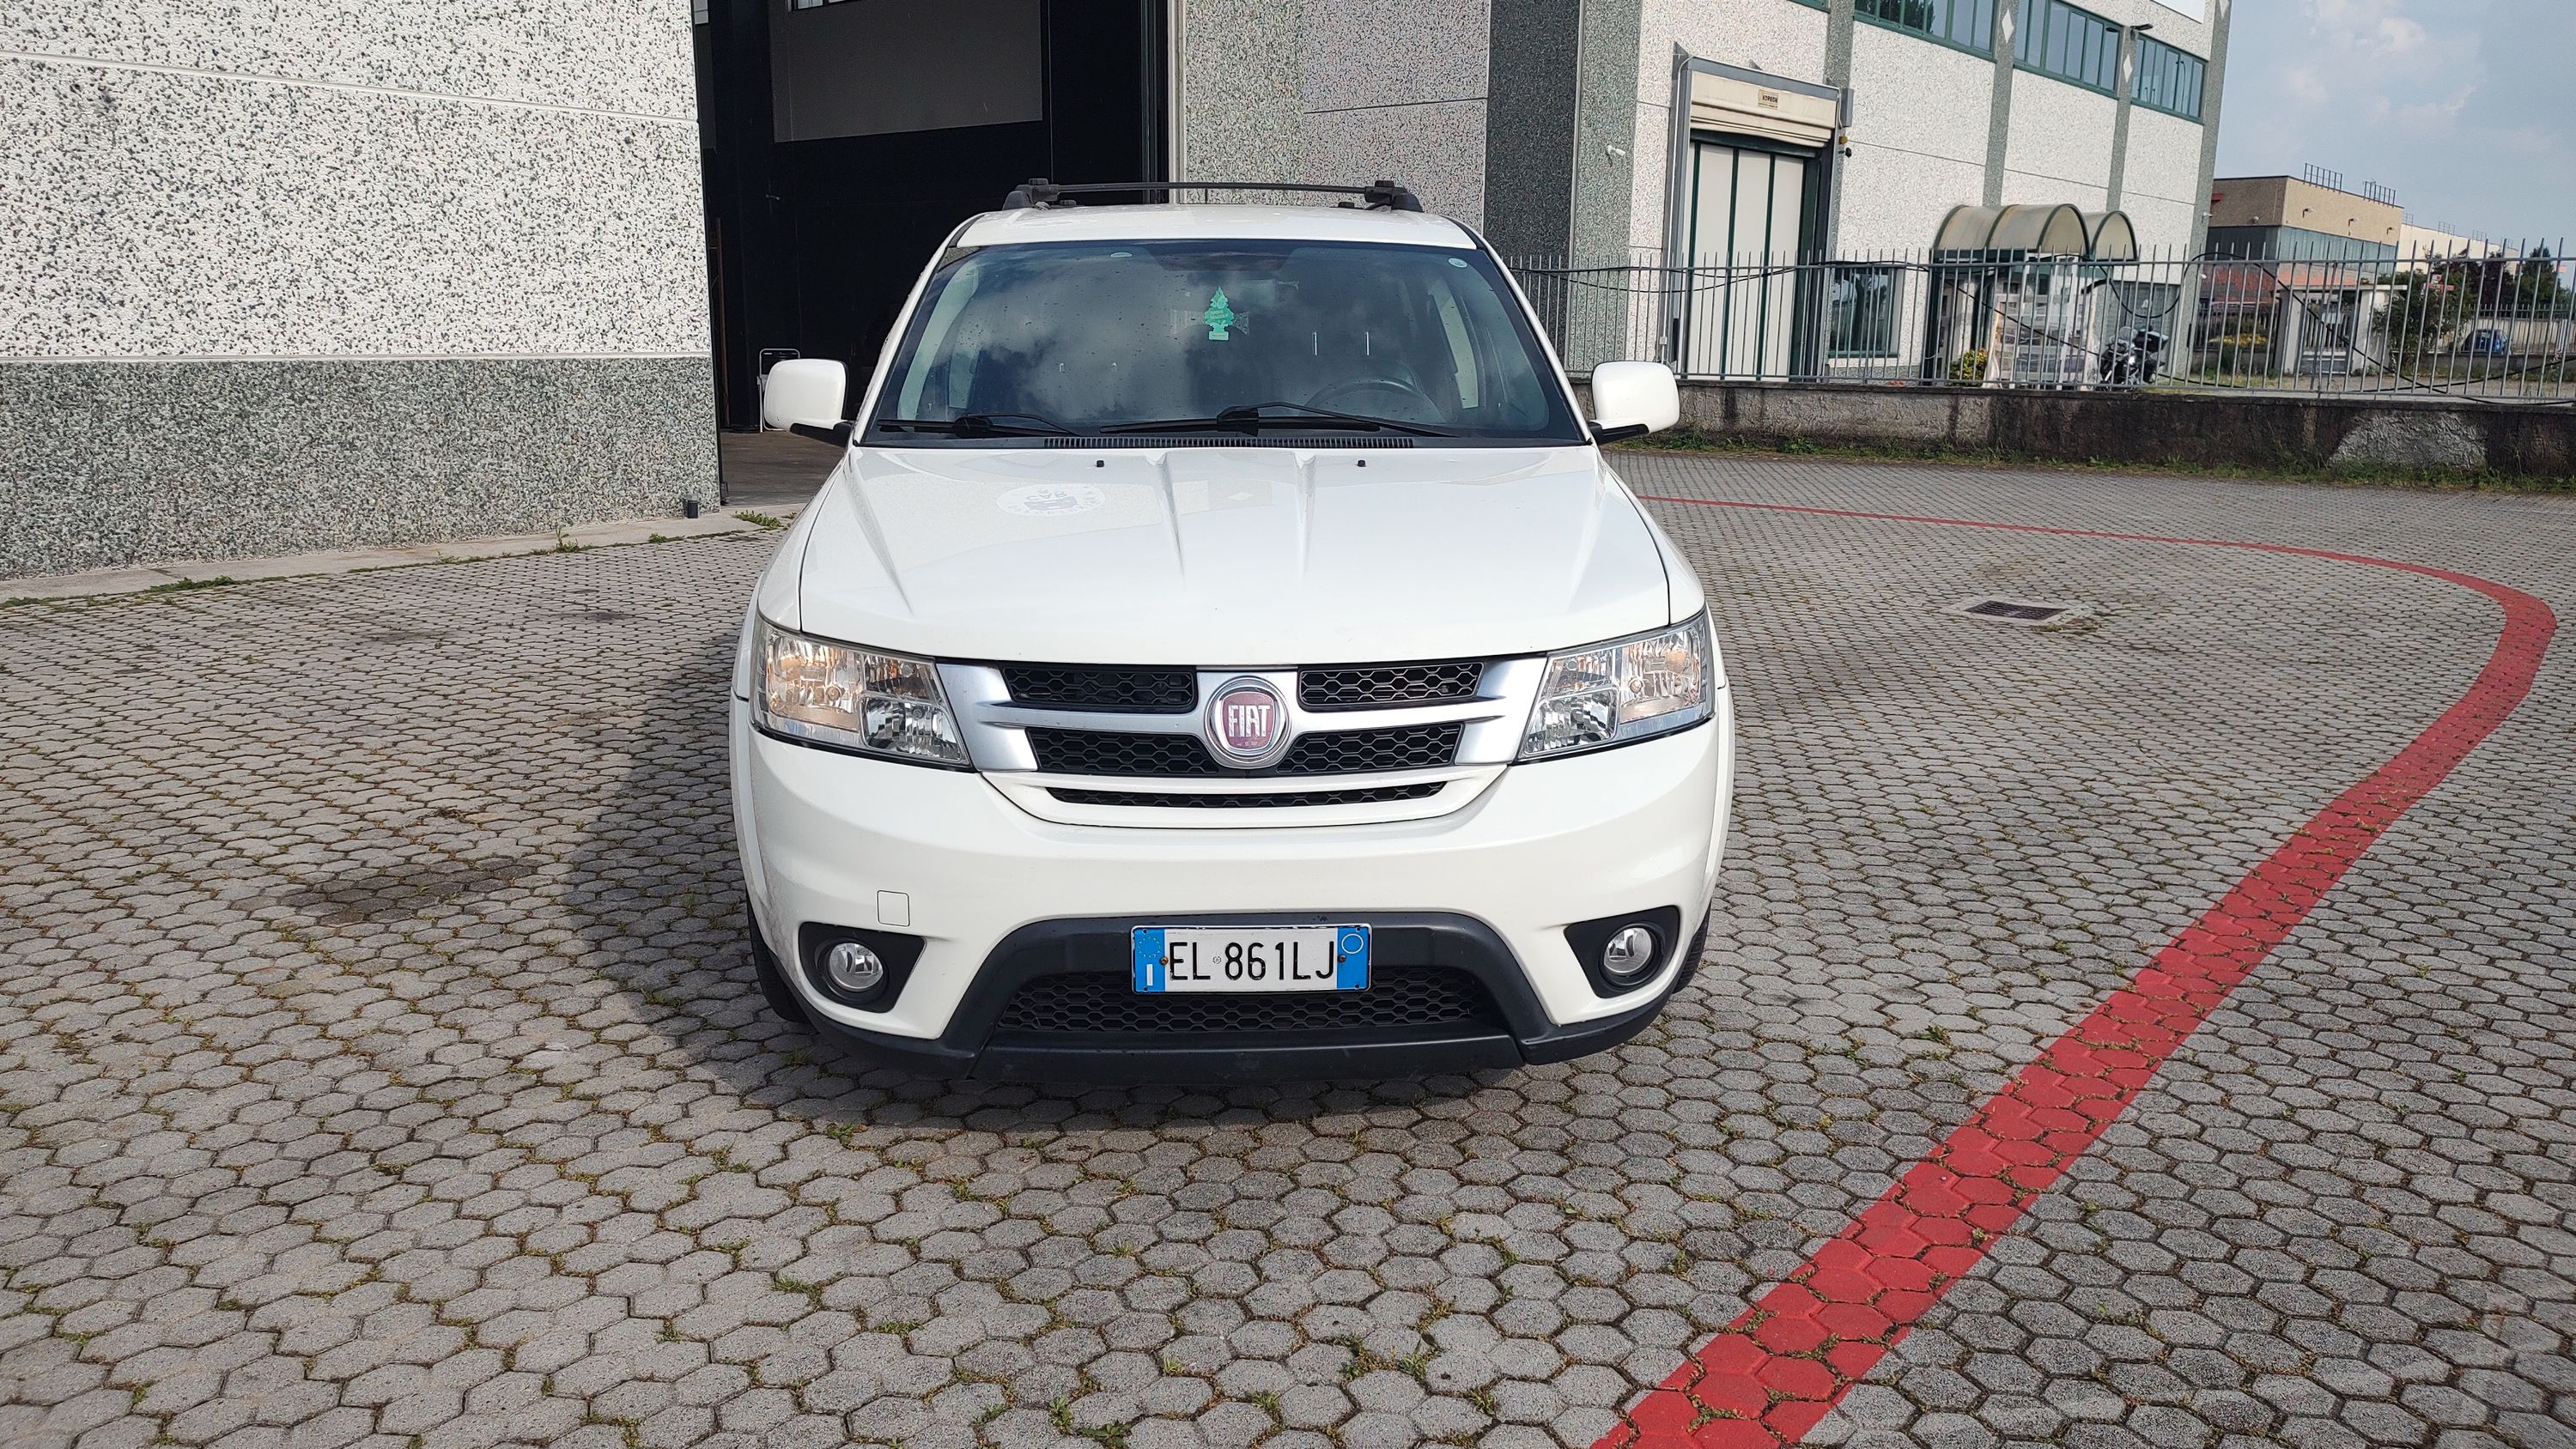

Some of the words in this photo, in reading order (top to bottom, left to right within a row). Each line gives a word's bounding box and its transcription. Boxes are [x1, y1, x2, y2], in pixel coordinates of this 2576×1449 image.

[1228, 705, 1270, 737] FIAT
[1146, 963, 1153, 986] I
[1170, 942, 1211, 980] EL
[1224, 941, 1334, 980] 861LJ
